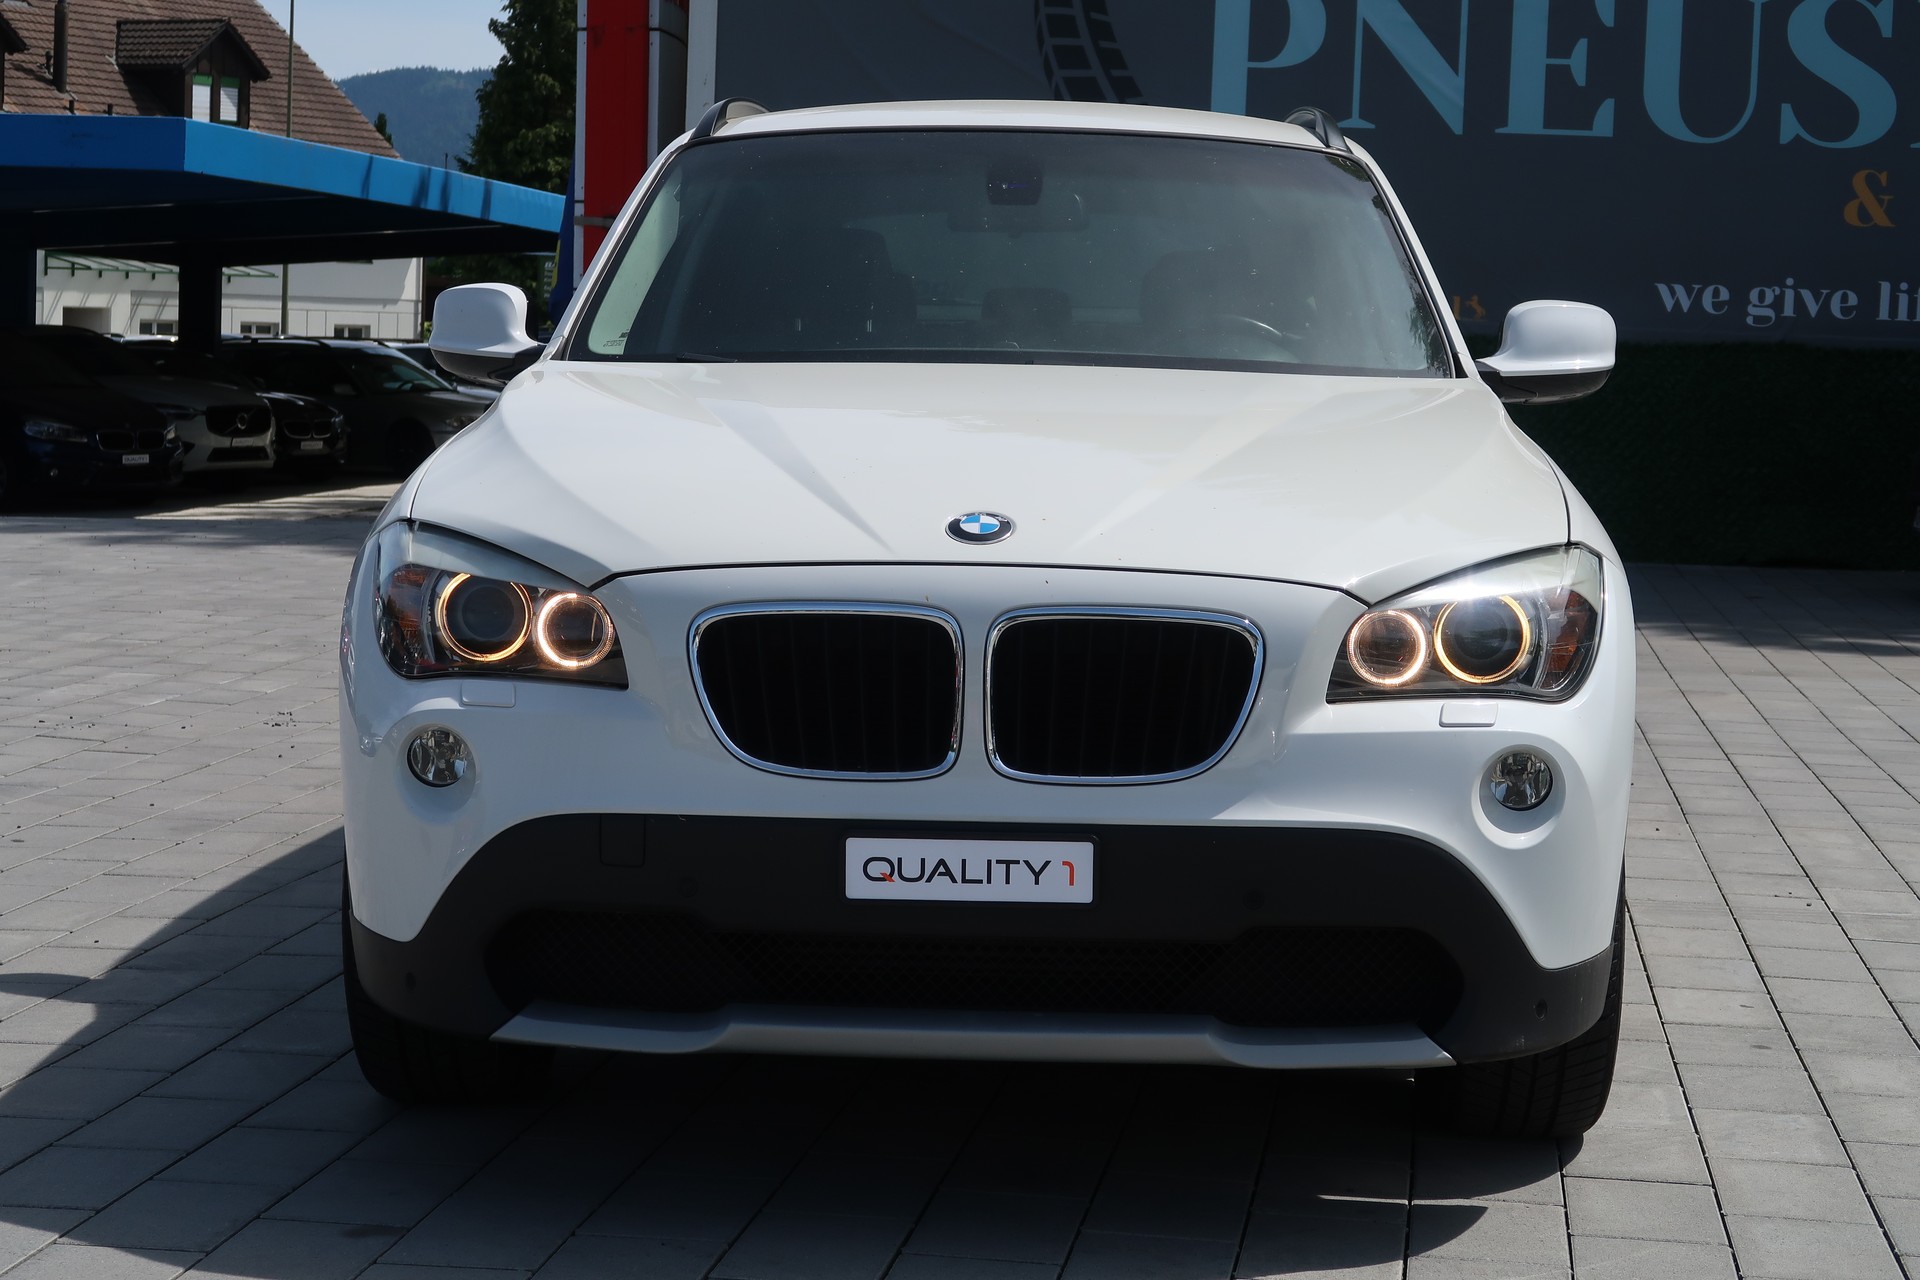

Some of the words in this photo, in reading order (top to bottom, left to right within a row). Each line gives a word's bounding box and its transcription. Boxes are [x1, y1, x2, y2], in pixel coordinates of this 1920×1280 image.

[1842, 168, 1896, 228] &
[1654, 282, 1730, 315] we
[1746, 277, 1859, 328] give
[1876, 280, 1920, 322] li
[862, 856, 1052, 886] QUALITY
[1061, 860, 1075, 887] 1
